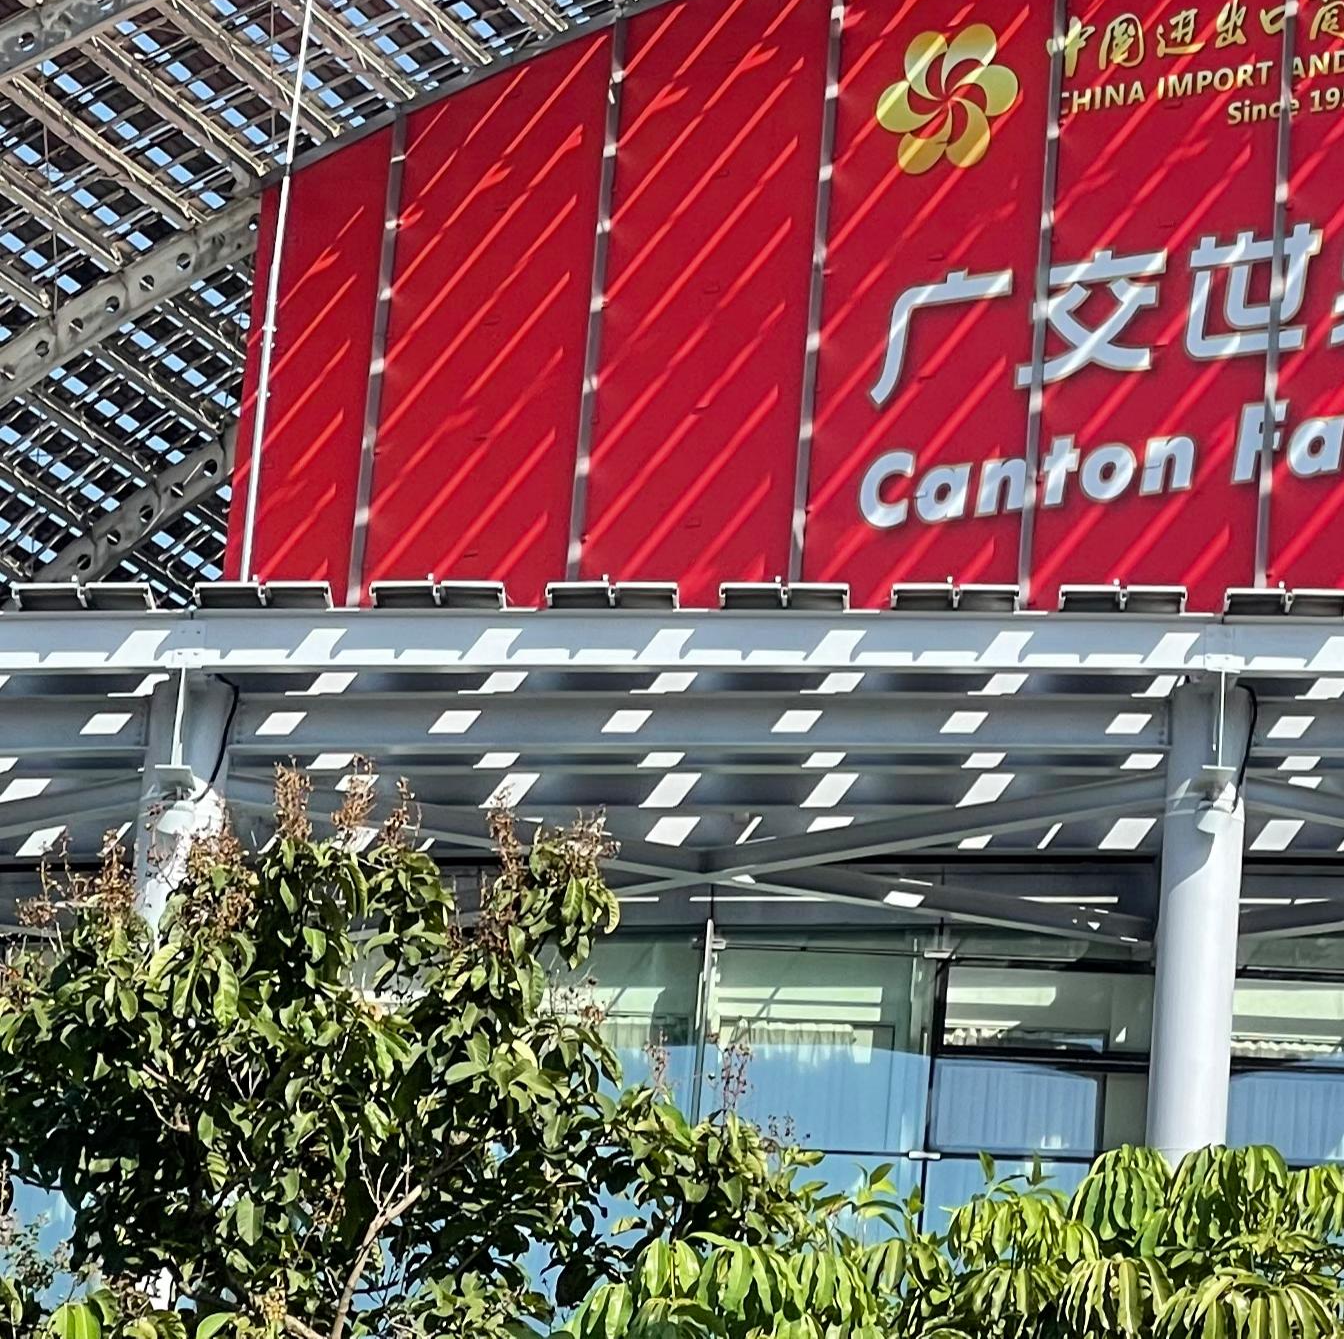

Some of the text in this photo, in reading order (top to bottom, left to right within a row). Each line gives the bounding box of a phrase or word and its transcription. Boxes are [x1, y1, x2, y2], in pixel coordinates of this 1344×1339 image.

[1157, 60, 1273, 100] IMPORT
[1227, 97, 1299, 126] Since
[858, 432, 1195, 530] Canton
